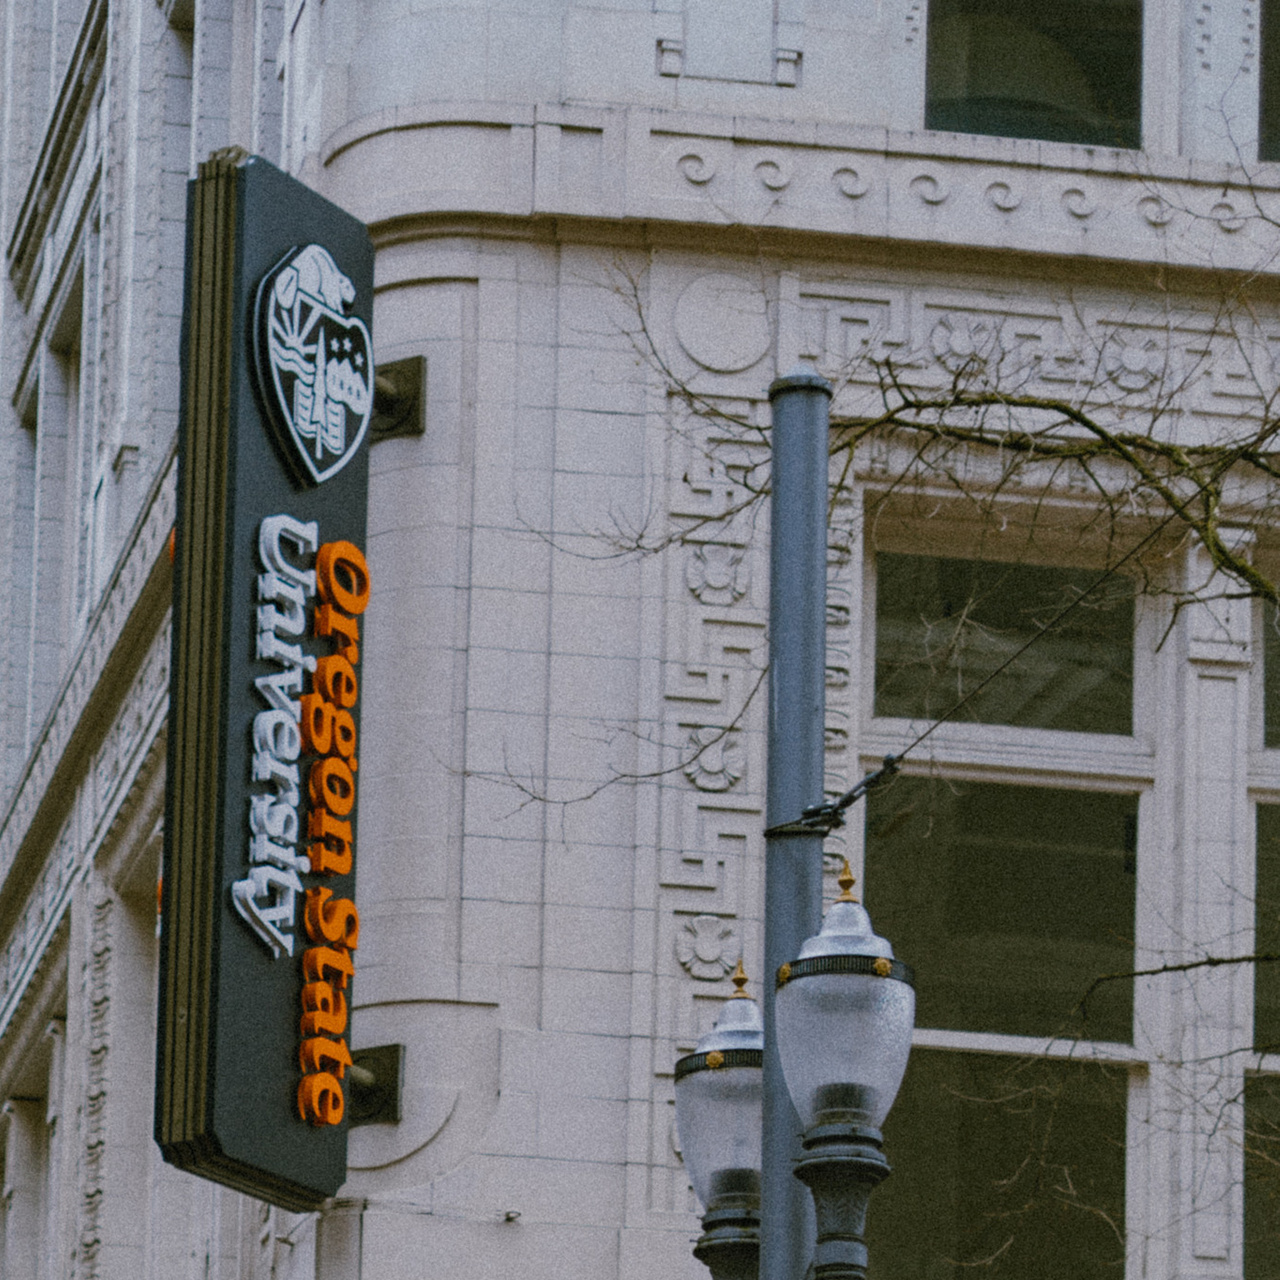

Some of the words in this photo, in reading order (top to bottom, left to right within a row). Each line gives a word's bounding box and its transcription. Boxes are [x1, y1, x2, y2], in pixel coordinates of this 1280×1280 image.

[232, 514, 318, 958] University
[300, 540, 370, 876] Oregon
[297, 886, 360, 1127] State
